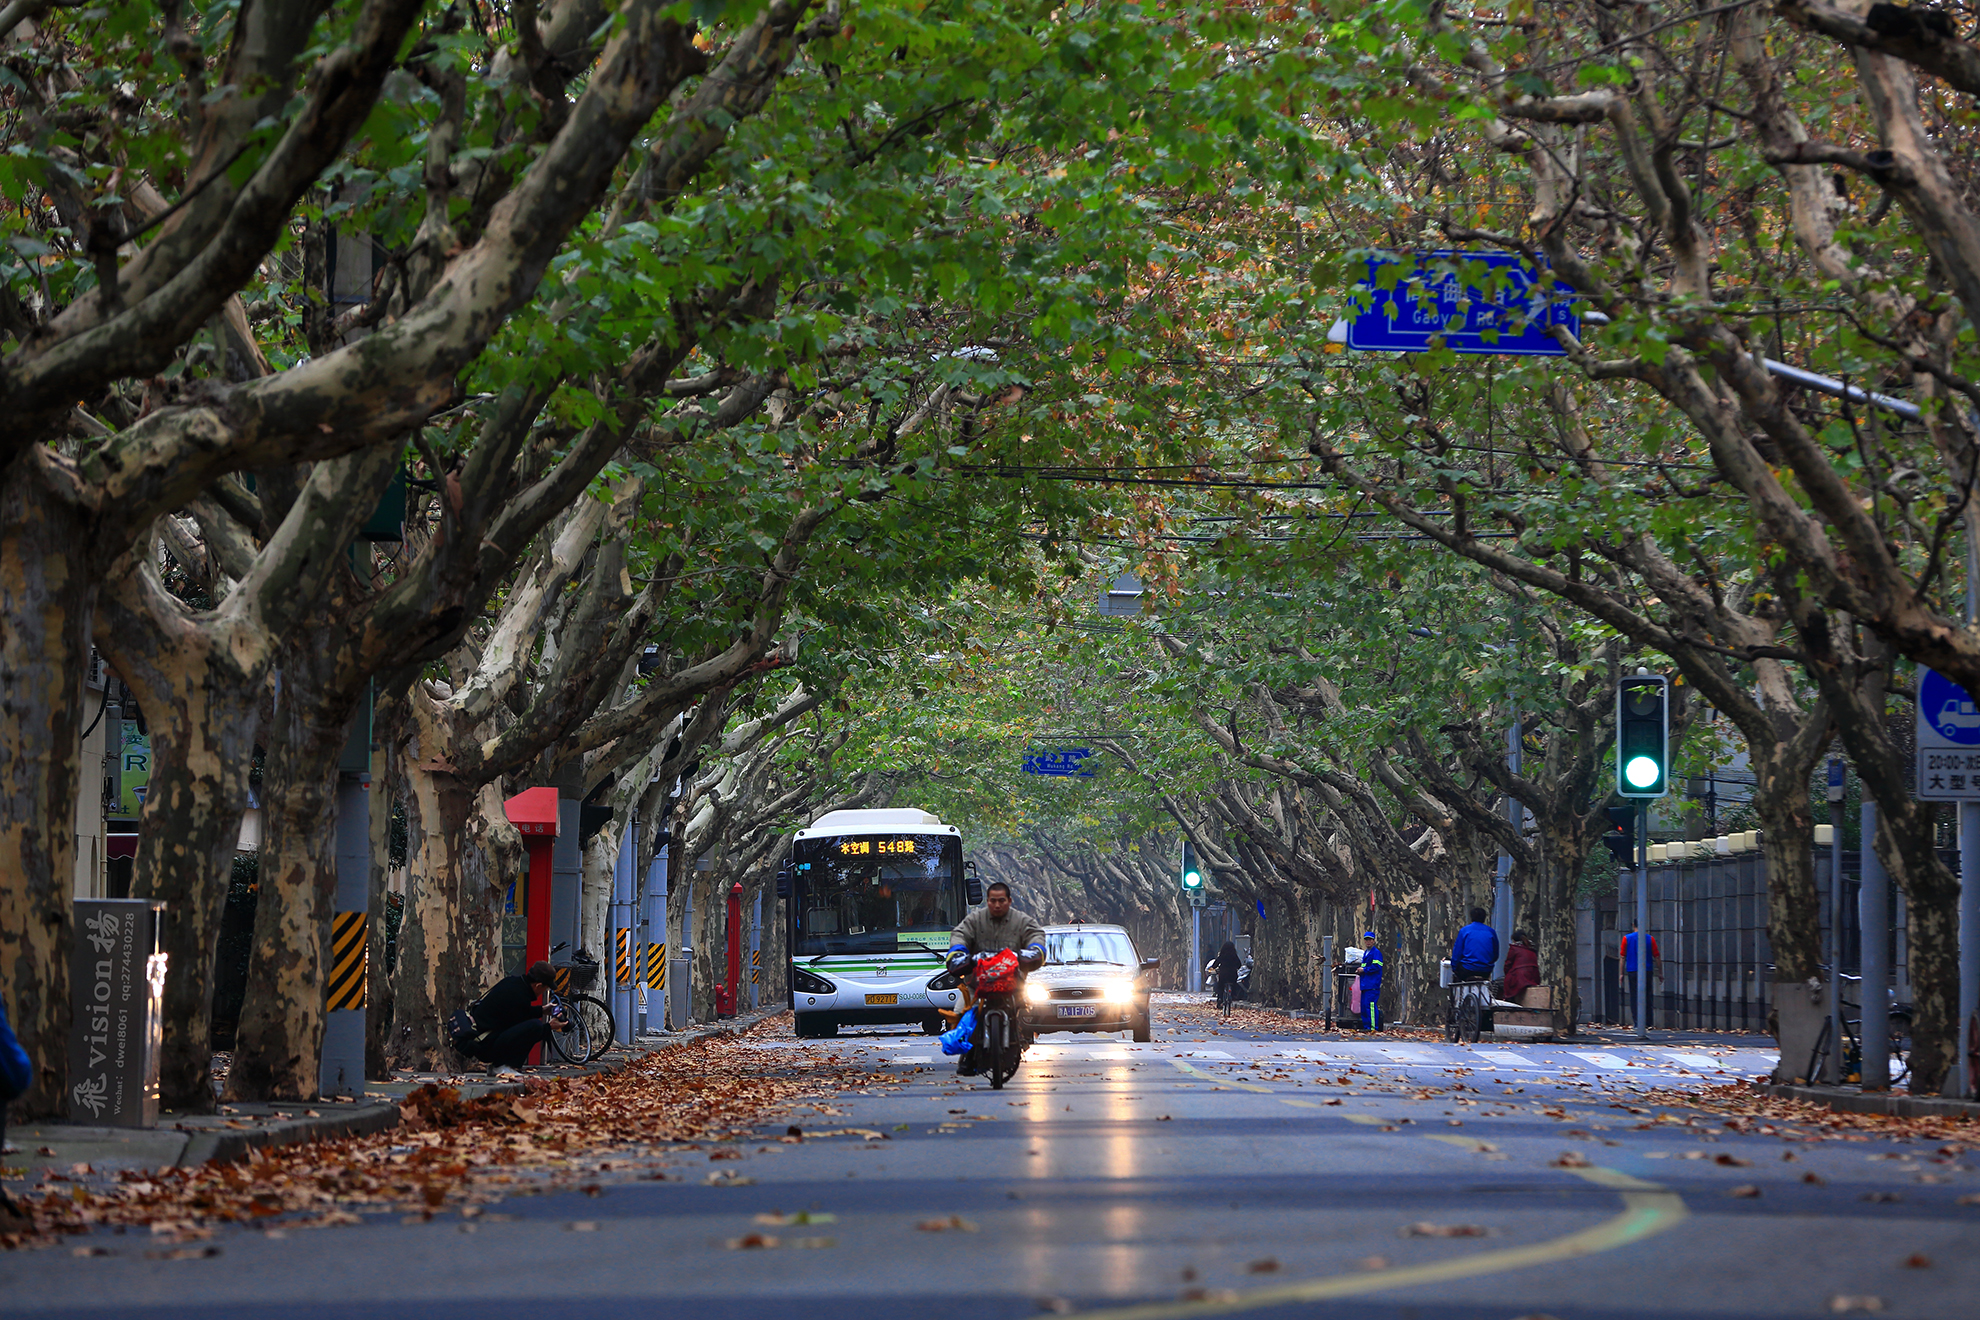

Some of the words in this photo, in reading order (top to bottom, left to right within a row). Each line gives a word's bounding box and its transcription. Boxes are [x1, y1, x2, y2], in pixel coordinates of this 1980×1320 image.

[1412, 309, 1468, 327] Gaoy
[850, 841, 870, 855] 空调
[878, 840, 915, 854] 548路
